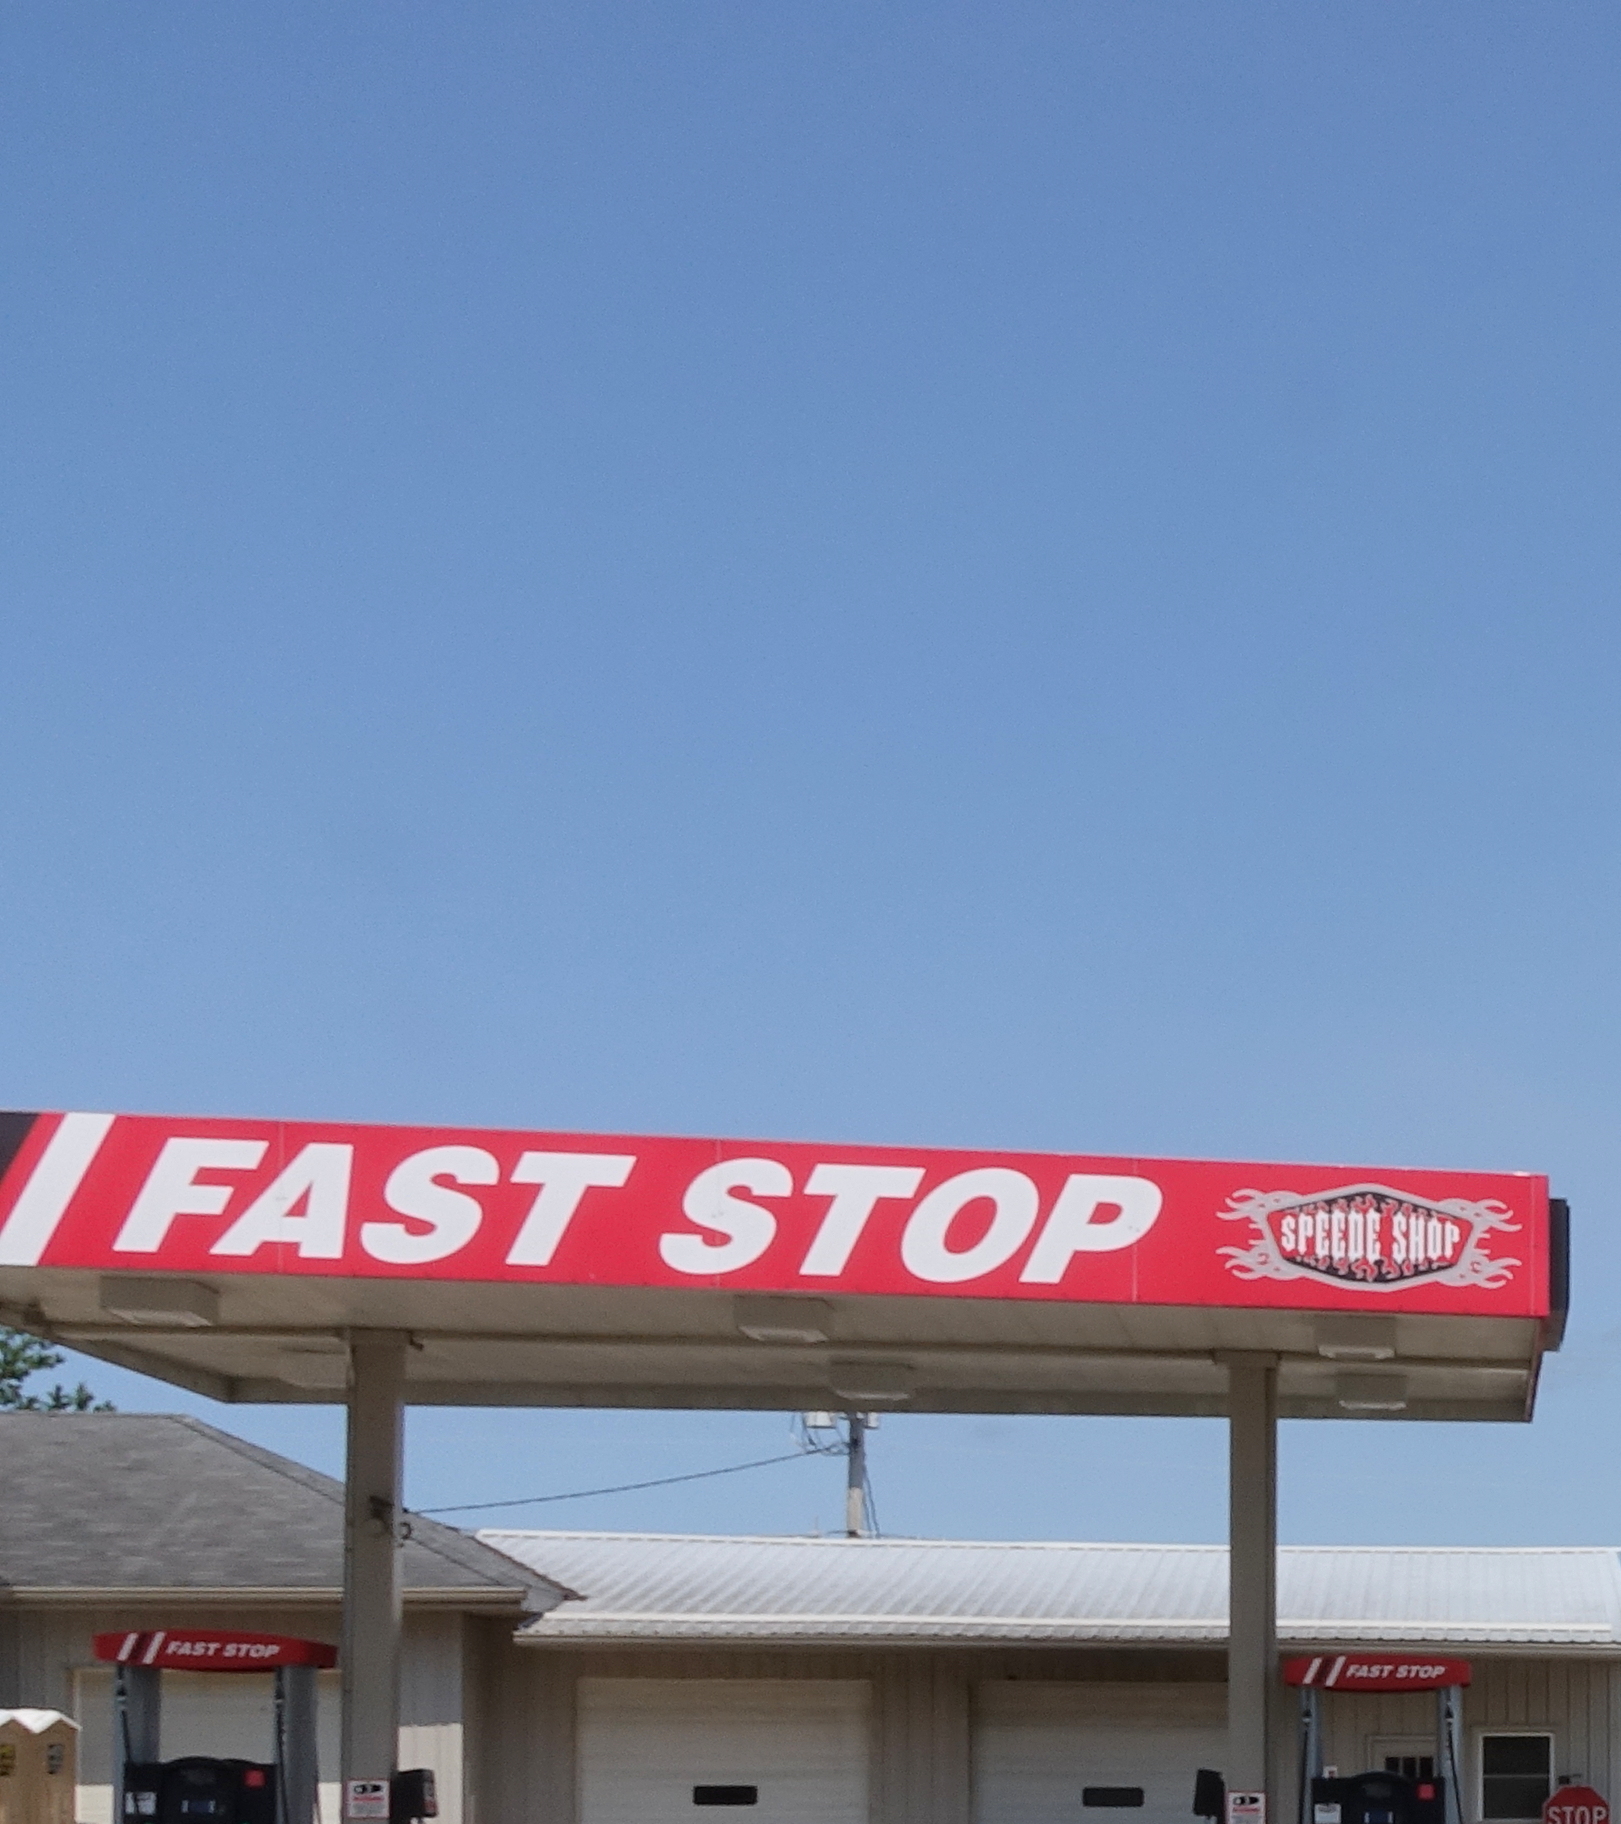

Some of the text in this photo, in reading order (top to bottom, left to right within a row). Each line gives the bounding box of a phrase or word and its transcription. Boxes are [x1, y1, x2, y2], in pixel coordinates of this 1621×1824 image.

[112, 1136, 1164, 1286] FAST STOP
[1281, 1208, 1461, 1265] SPEEDE SHOP
[165, 1640, 280, 1659] FAST STOP
[1345, 1663, 1446, 1679] FAST STOP
